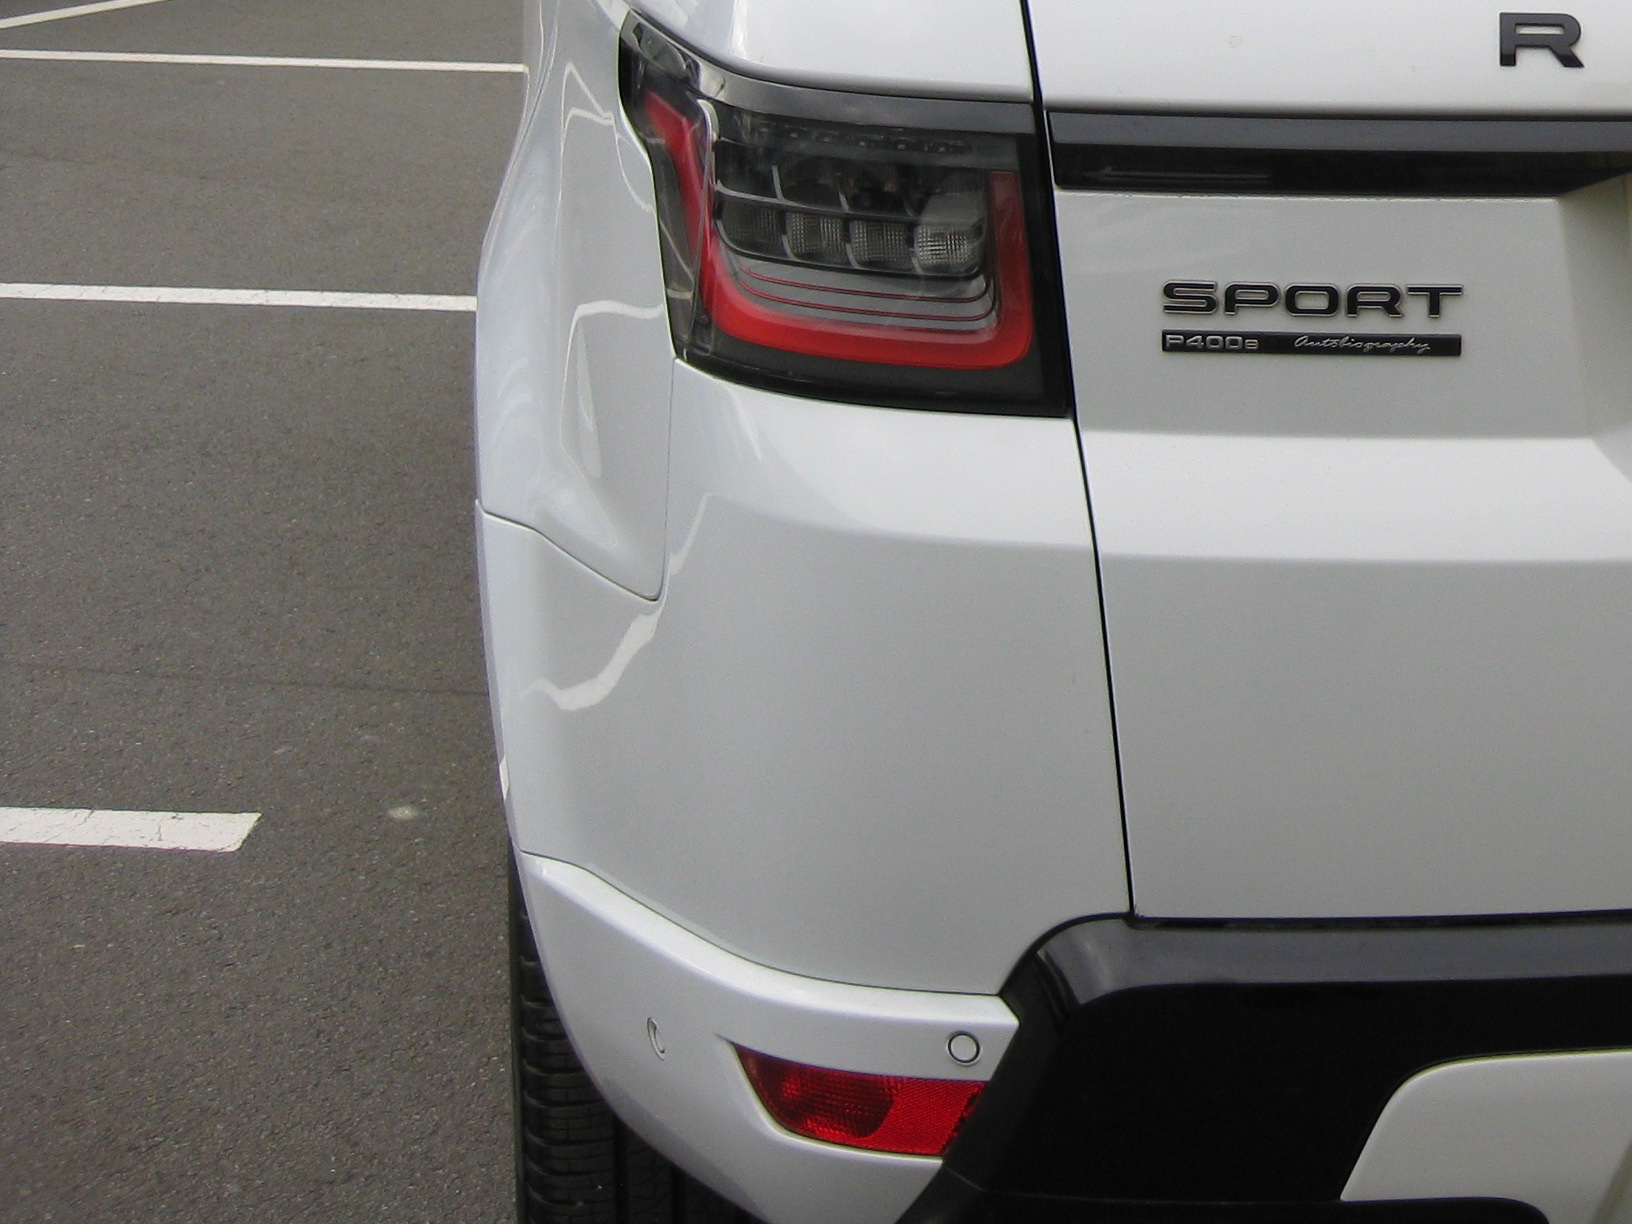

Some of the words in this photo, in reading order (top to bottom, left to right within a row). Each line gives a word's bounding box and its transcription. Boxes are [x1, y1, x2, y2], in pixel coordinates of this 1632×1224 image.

[1162, 279, 1464, 319] SPORT
[1165, 333, 1260, 351] P400e
[1293, 334, 1432, 353] Autobiography
